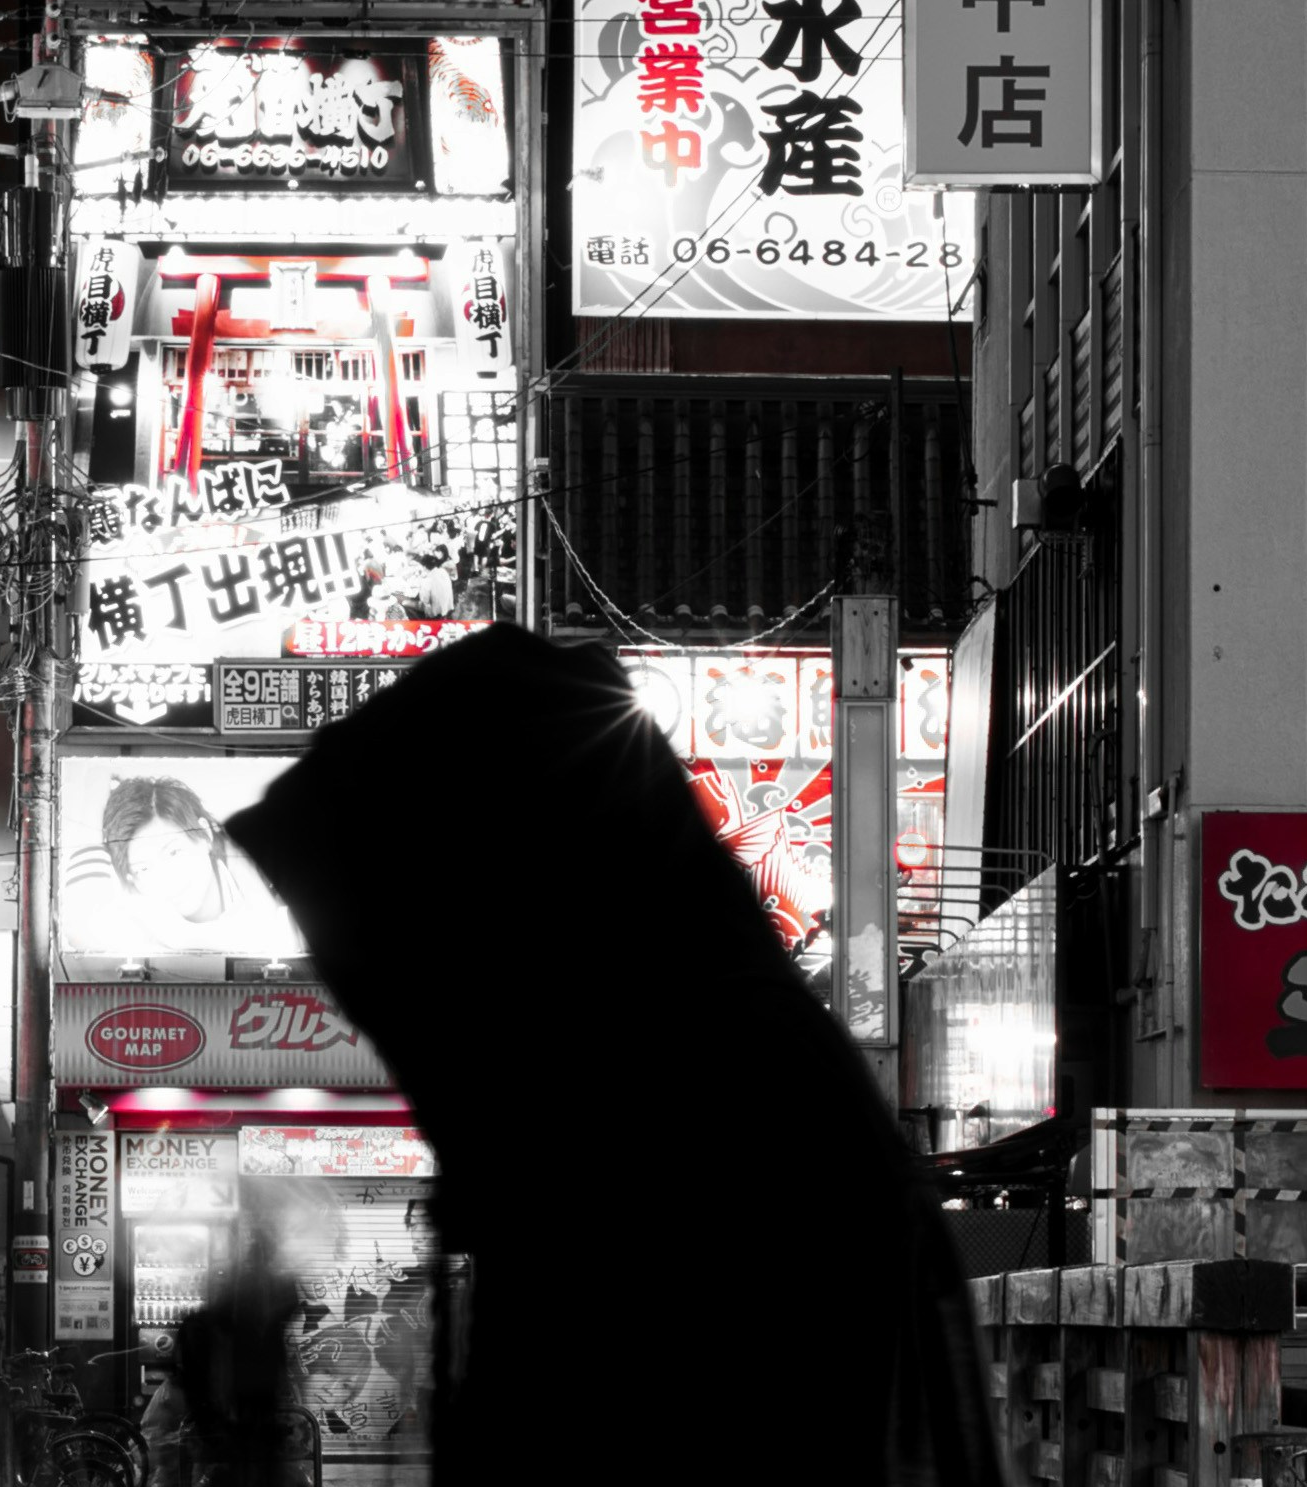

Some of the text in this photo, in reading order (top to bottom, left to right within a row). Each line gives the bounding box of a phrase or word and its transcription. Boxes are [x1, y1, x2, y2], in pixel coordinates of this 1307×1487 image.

[586, 235, 966, 270] 電話 06-6484-28
[80, 246, 116, 356] 虎目横丁
[470, 247, 508, 360] 虎目横丁
[293, 618, 490, 654] 昼12時から営
[224, 669, 300, 703] 全9店舗
[306, 670, 325, 728] からあげ
[226, 705, 280, 726] 虎目横丁
[100, 1027, 187, 1043] GOURMET
[234, 996, 360, 1051] グルメ
[124, 1042, 163, 1057] MAP
[125, 1137, 217, 1156] MONEY
[126, 1157, 218, 1170] EXCHANGE
[74, 1135, 89, 1227] EXCHANGE
[89, 1135, 109, 1228] MONEY
